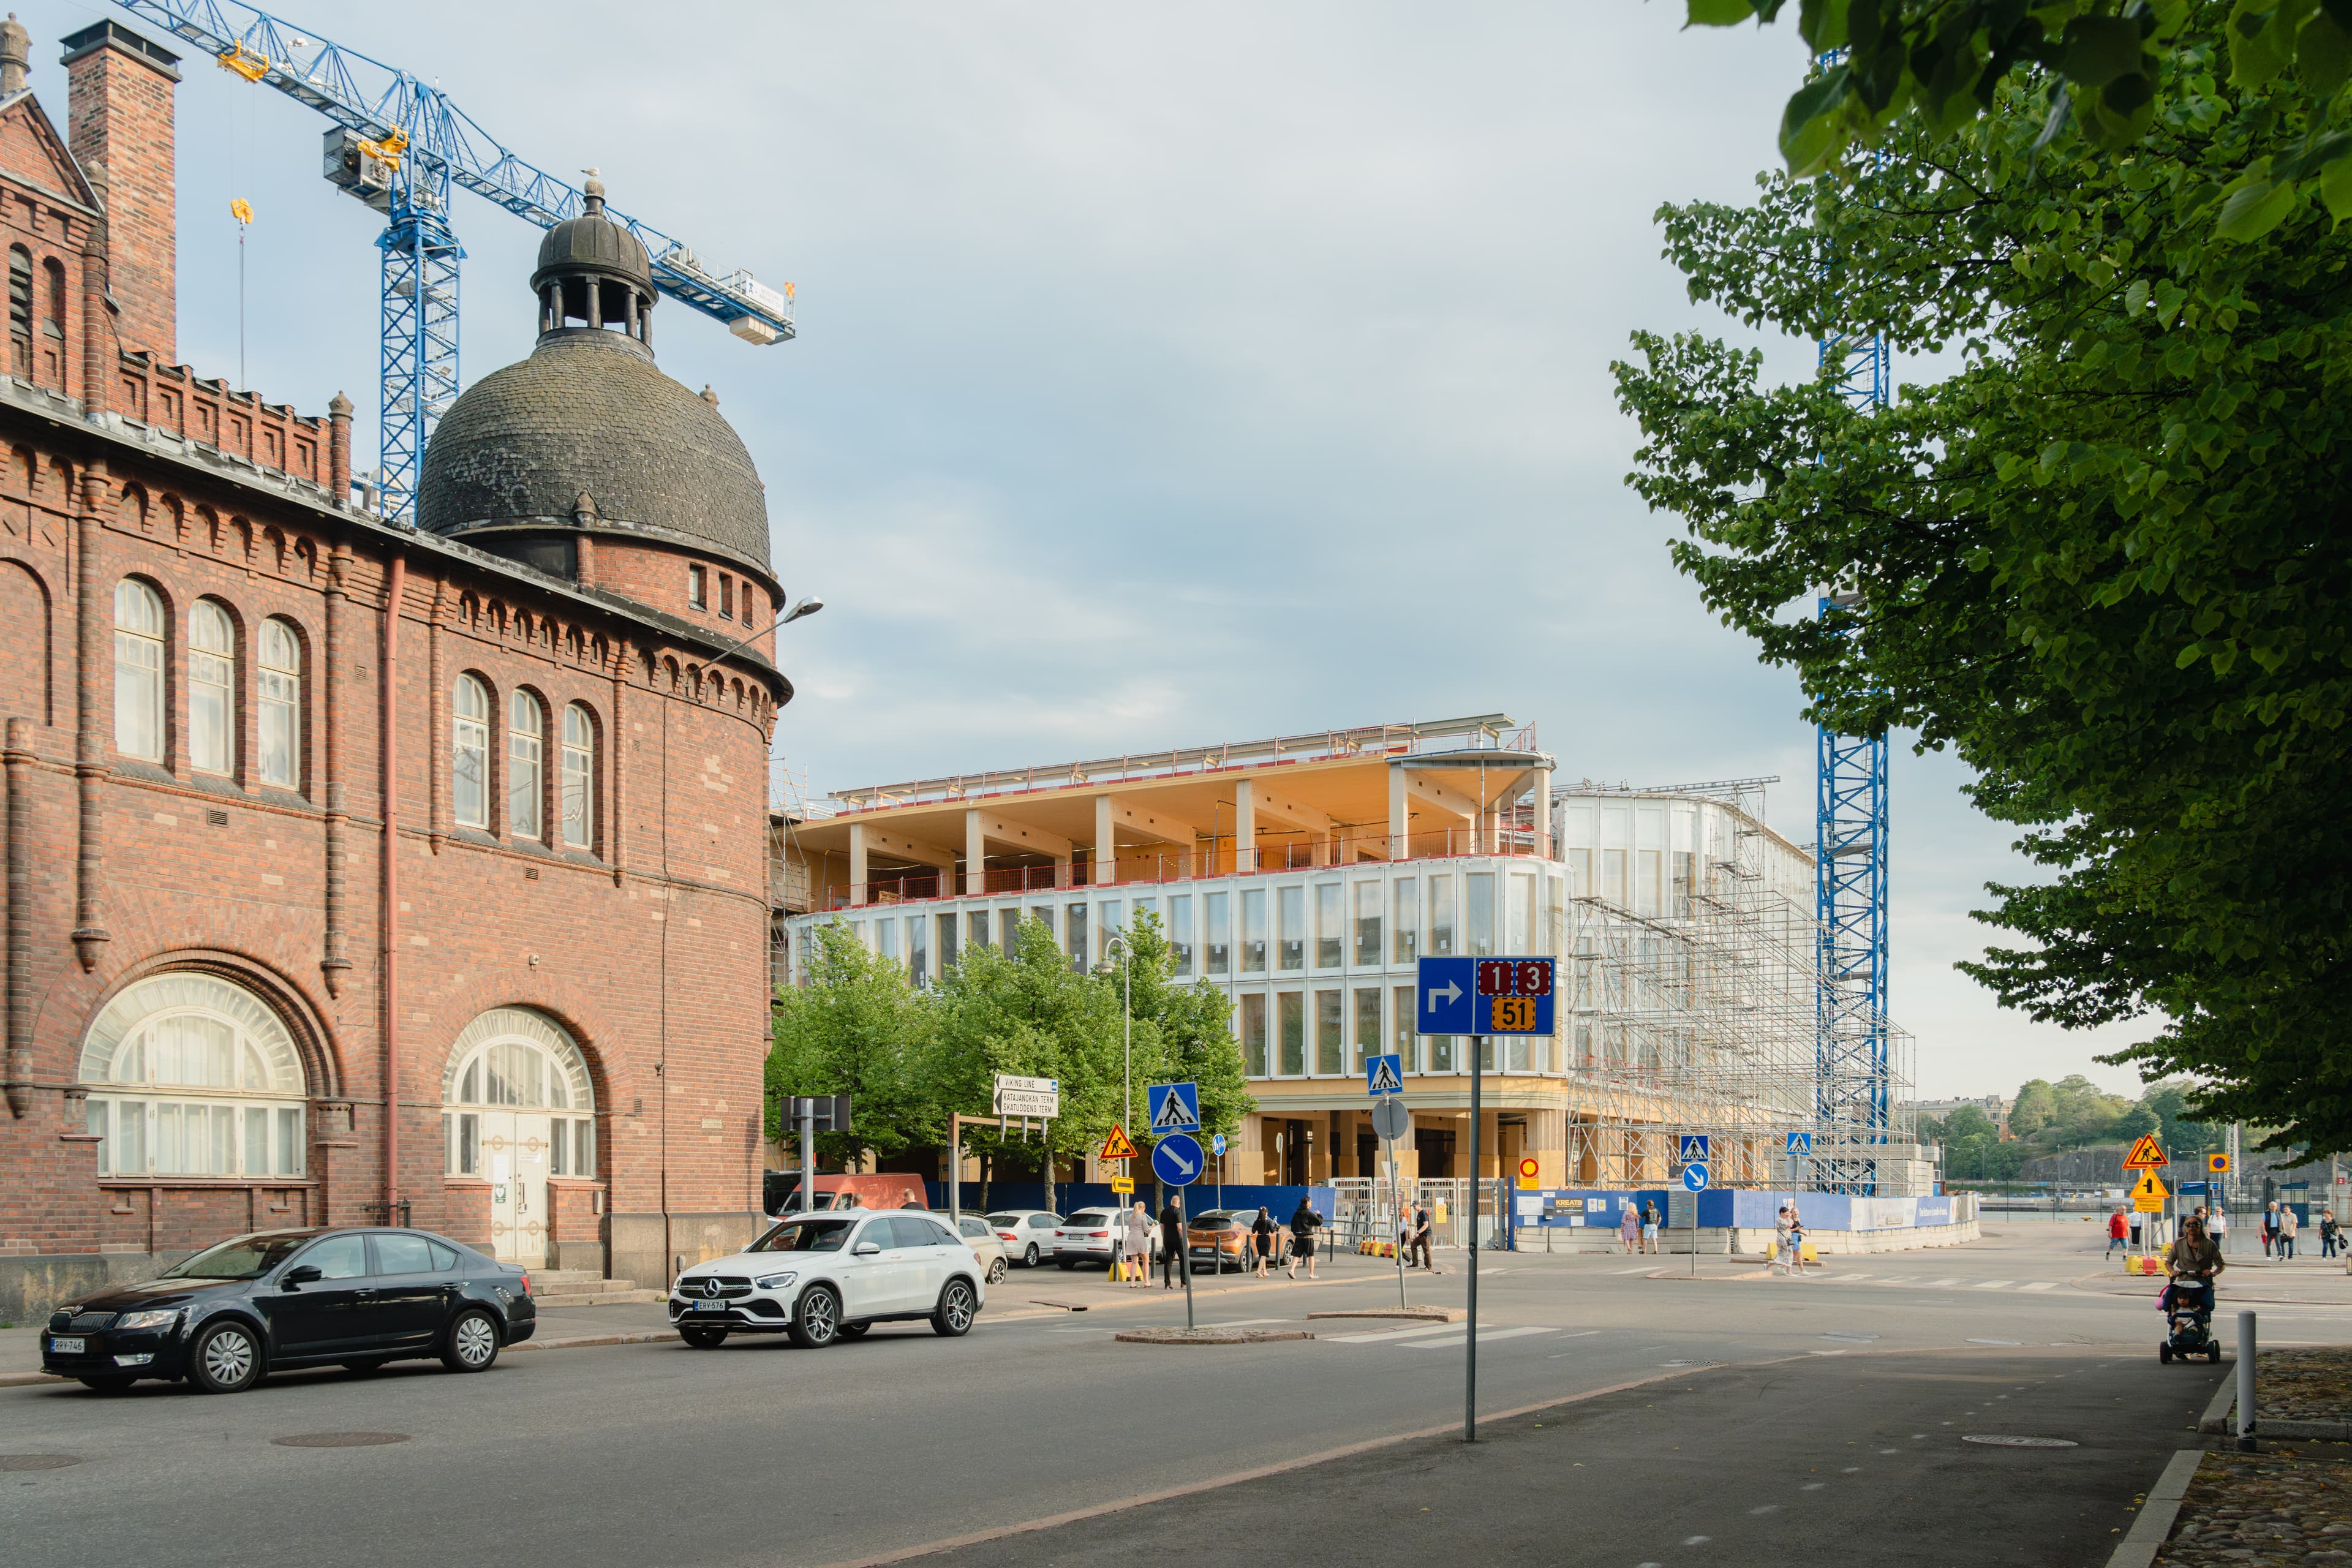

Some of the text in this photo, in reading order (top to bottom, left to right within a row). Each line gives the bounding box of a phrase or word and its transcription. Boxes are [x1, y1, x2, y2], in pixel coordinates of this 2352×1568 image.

[1493, 967, 1500, 990] 1
[1526, 967, 1540, 990] 3
[1502, 1002, 1525, 1025] 51
[1005, 1078, 1022, 1087] VIKING
[1004, 1093, 1039, 1102] KATAJANOKAN
[1003, 1103, 1037, 1112] SKATUDDENS
